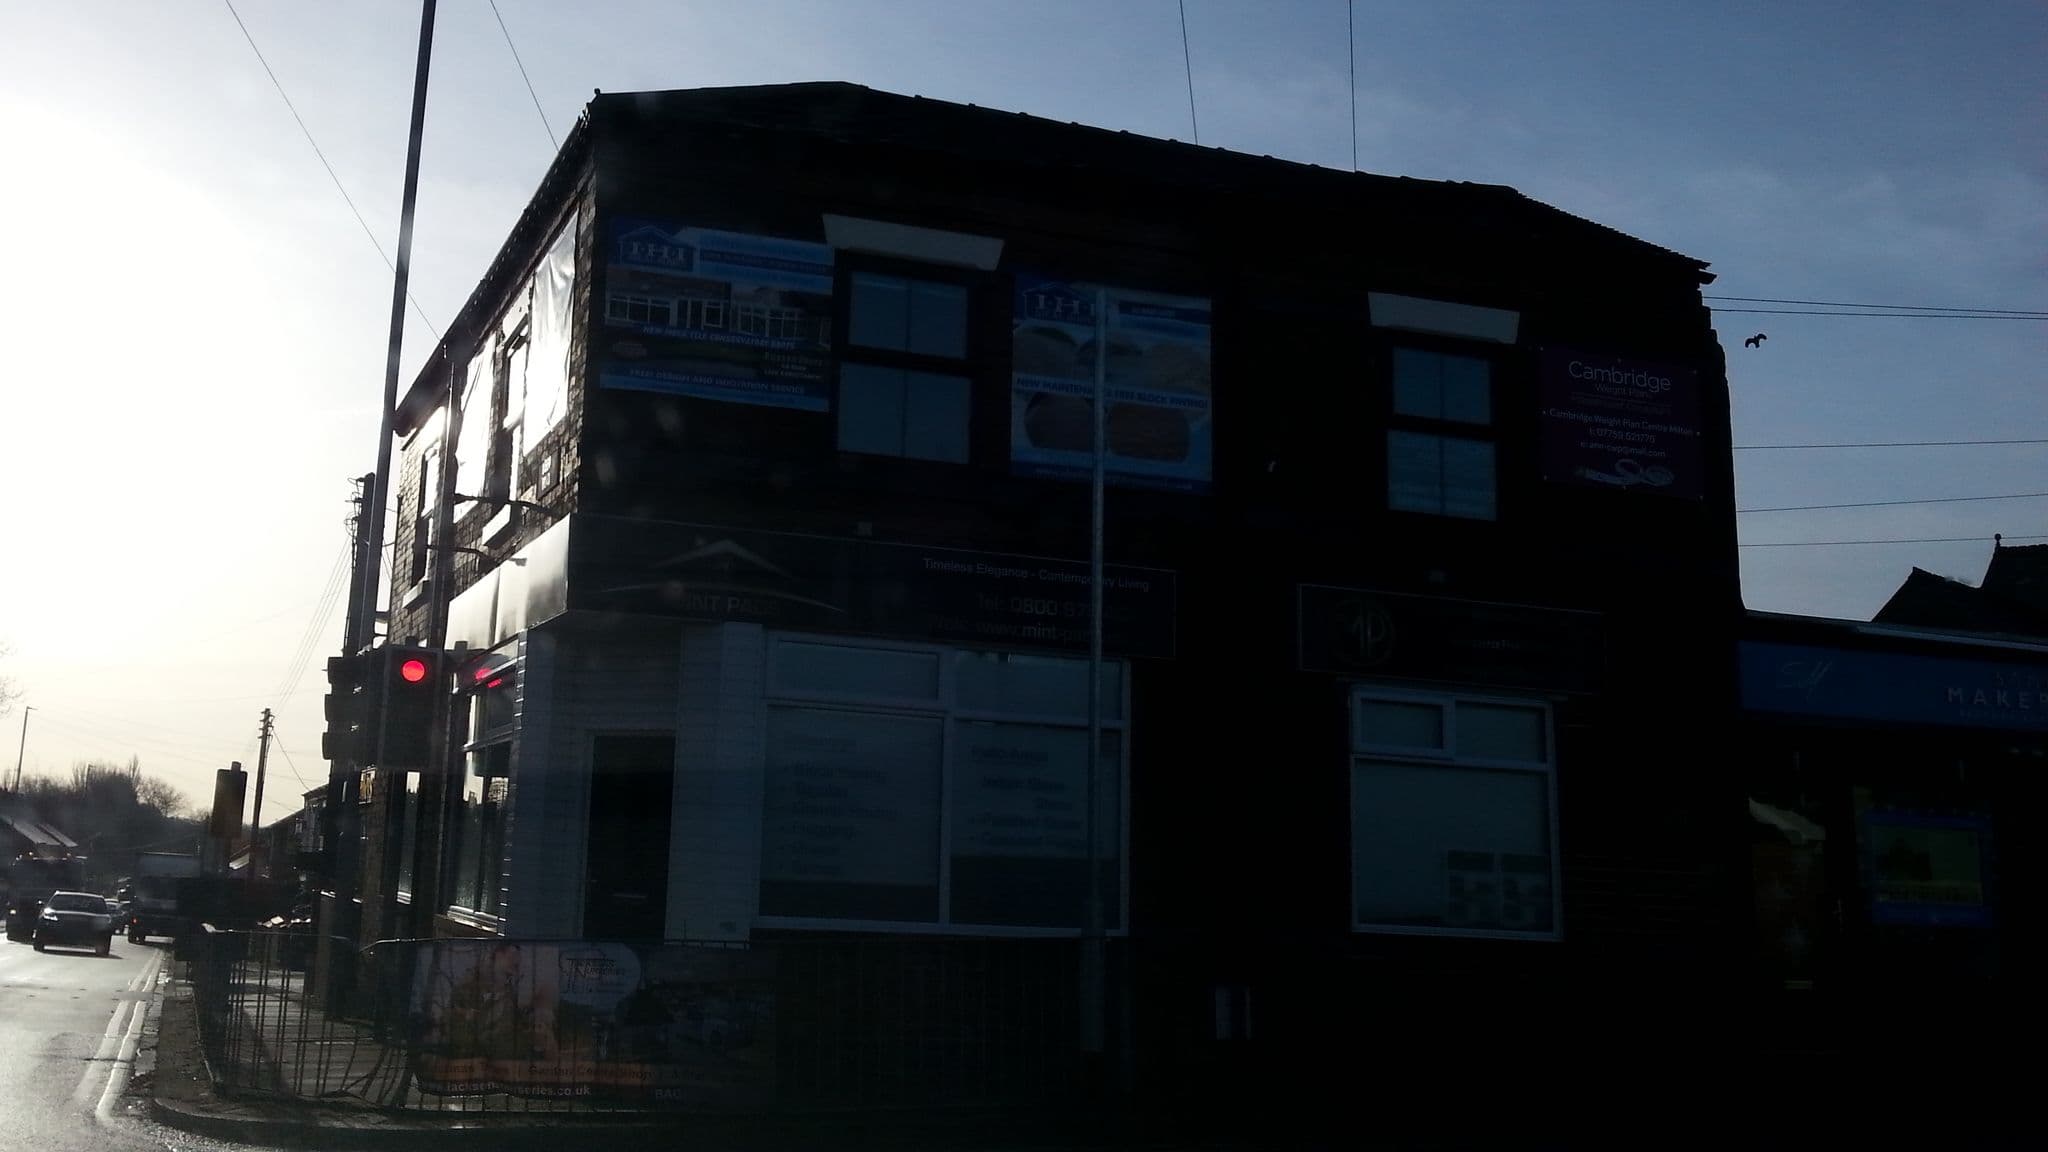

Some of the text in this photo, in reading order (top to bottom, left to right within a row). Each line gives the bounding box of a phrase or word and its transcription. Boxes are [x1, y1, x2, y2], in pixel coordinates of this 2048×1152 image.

[1568, 360, 1672, 393] Cambridge
[1550, 408, 1594, 424] Cambridge
[1595, 415, 1622, 427] Weight
[1623, 418, 1641, 429] Plan
[923, 558, 974, 573] Timeless
[976, 563, 1029, 579] Elegance
[1117, 576, 1150, 592] Living
[1008, 597, 1058, 617] 0800
